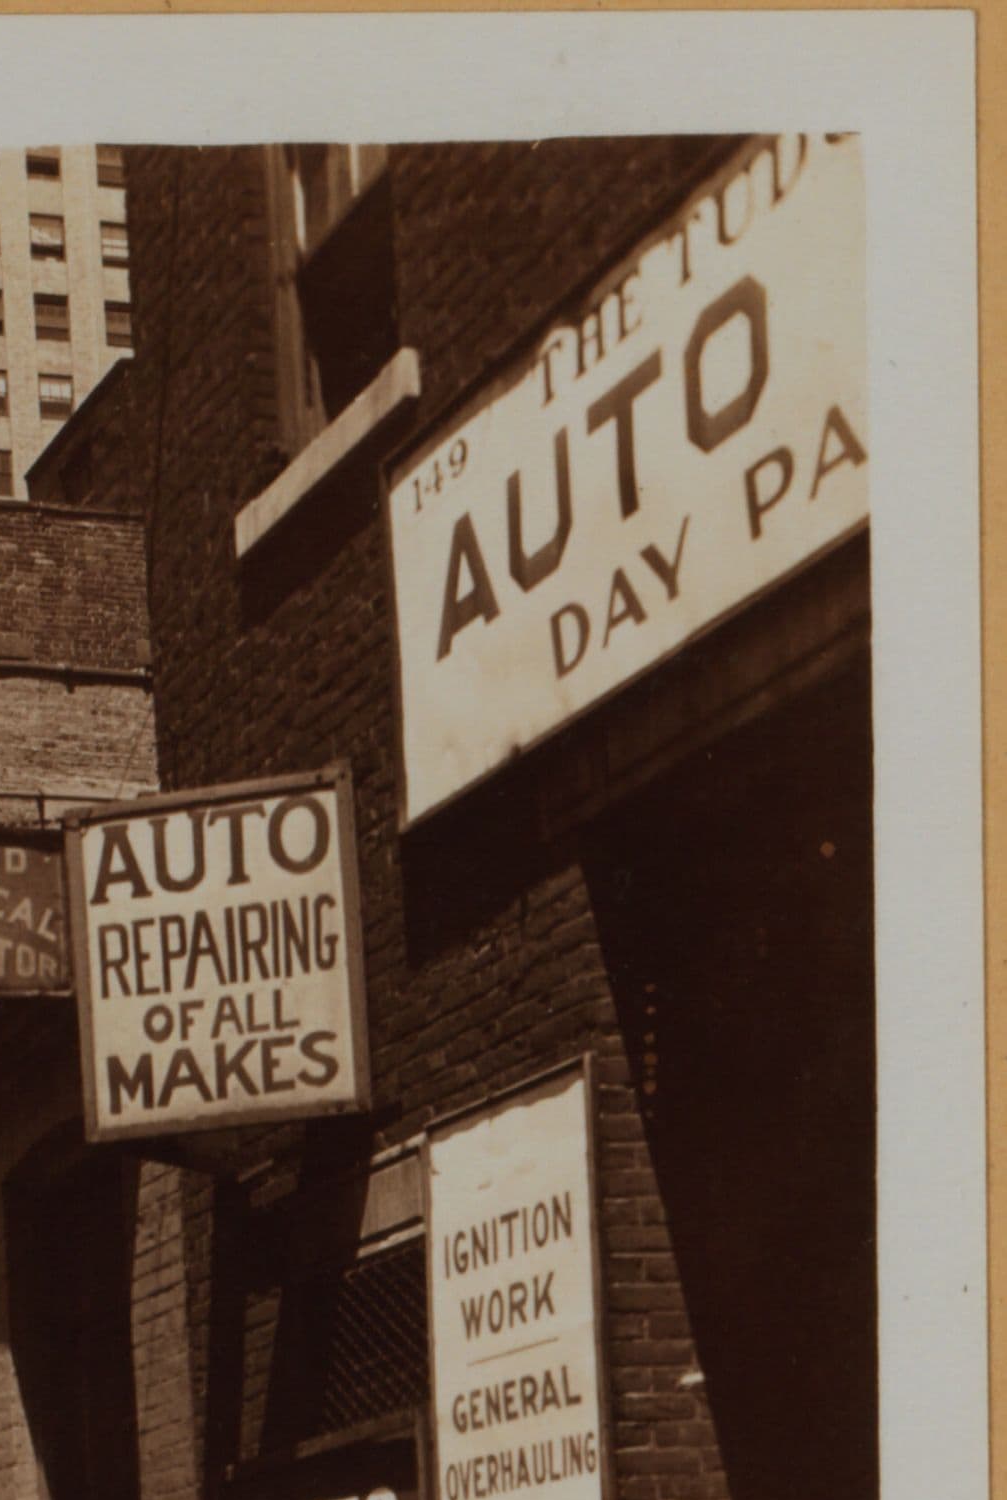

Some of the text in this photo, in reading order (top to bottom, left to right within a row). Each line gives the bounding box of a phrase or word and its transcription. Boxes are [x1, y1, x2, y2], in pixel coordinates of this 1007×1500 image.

[411, 440, 469, 514] 149
[436, 274, 769, 664] AUTO
[549, 404, 868, 681] DAY PA
[90, 796, 331, 906] AUTO
[98, 893, 339, 999] REPAIRING
[144, 988, 301, 1044] OF ALL
[106, 1030, 340, 1116] MAKES
[444, 1191, 573, 1280] IGNITION
[460, 1271, 556, 1342] WORK
[452, 1364, 582, 1434] GENERAL
